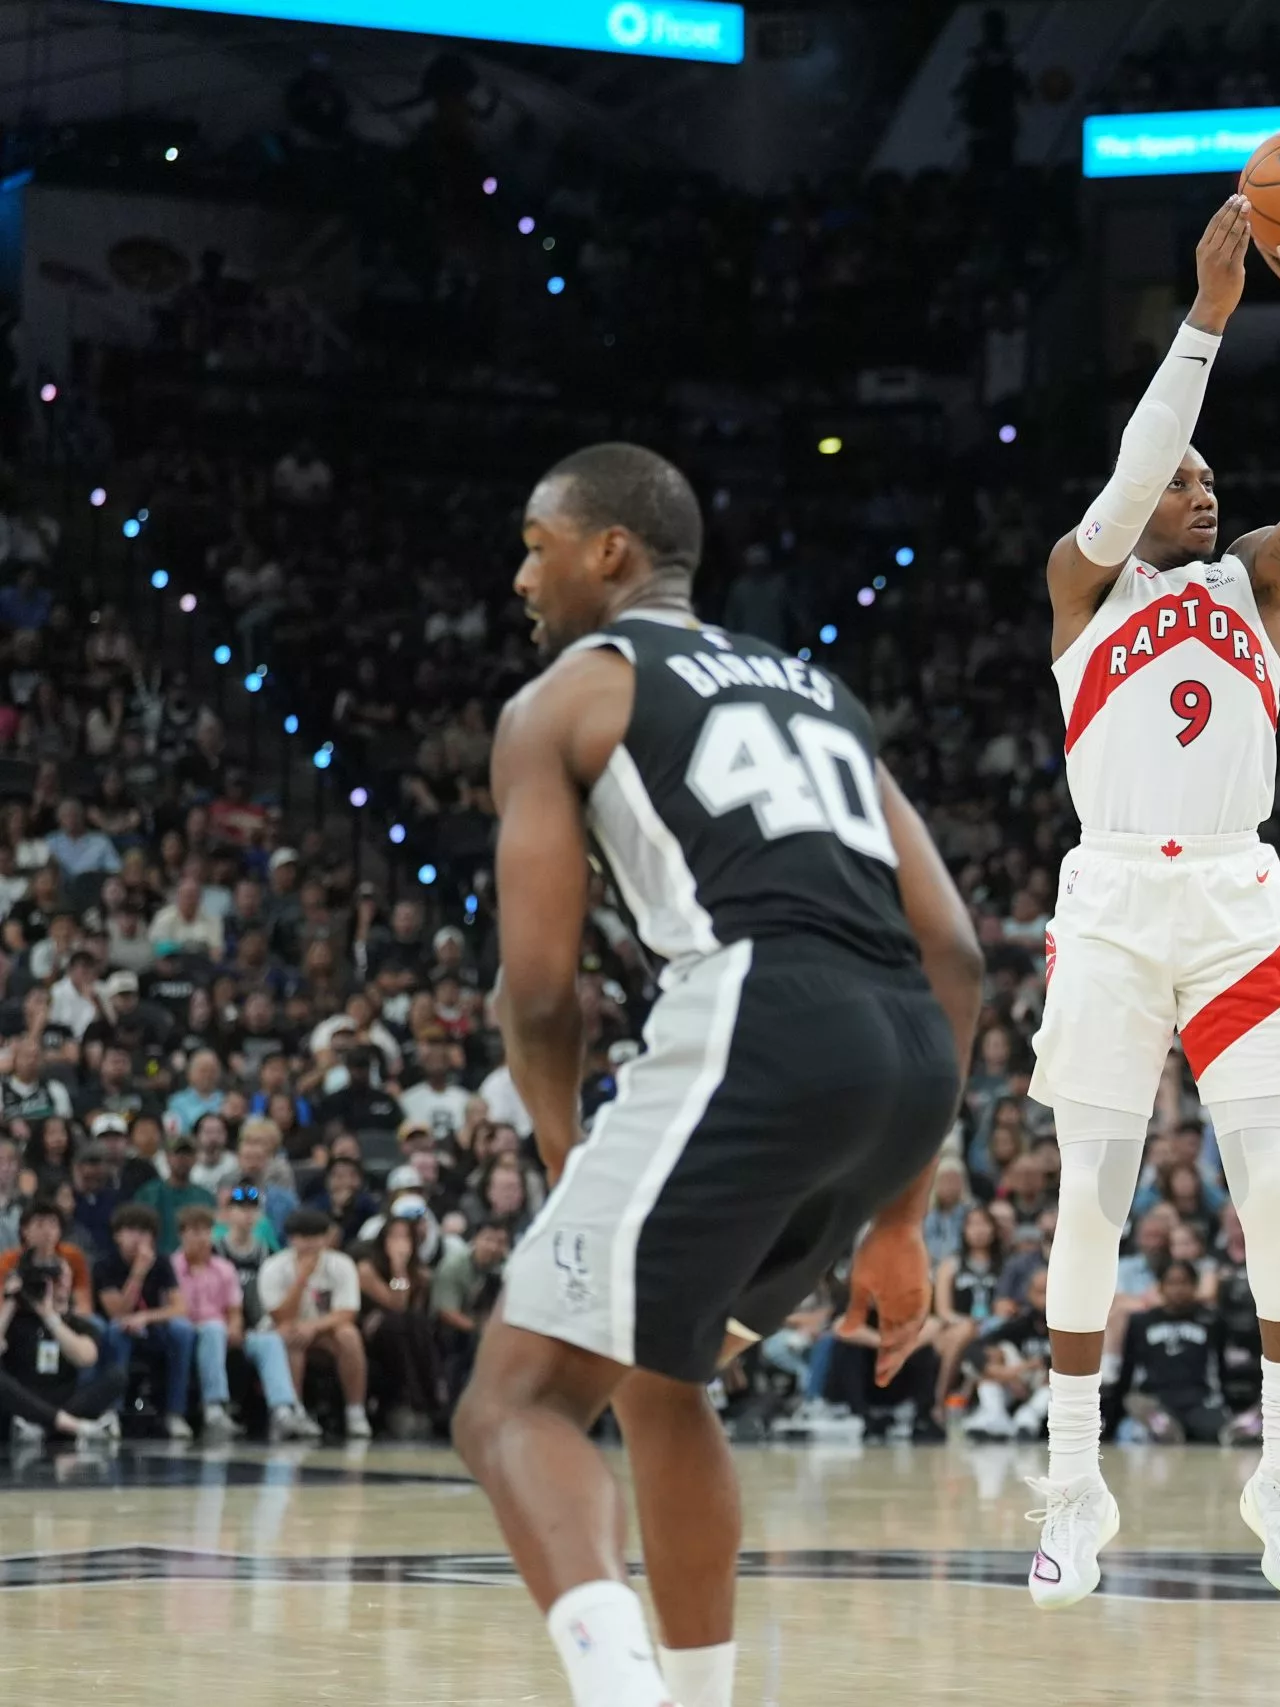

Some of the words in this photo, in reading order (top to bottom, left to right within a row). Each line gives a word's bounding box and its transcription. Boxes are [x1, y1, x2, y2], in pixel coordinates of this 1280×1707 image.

[1109, 598, 1266, 683] RAPTORS
[665, 651, 834, 711] BARNES
[1170, 680, 1212, 748] 9
[684, 702, 900, 869] 40
